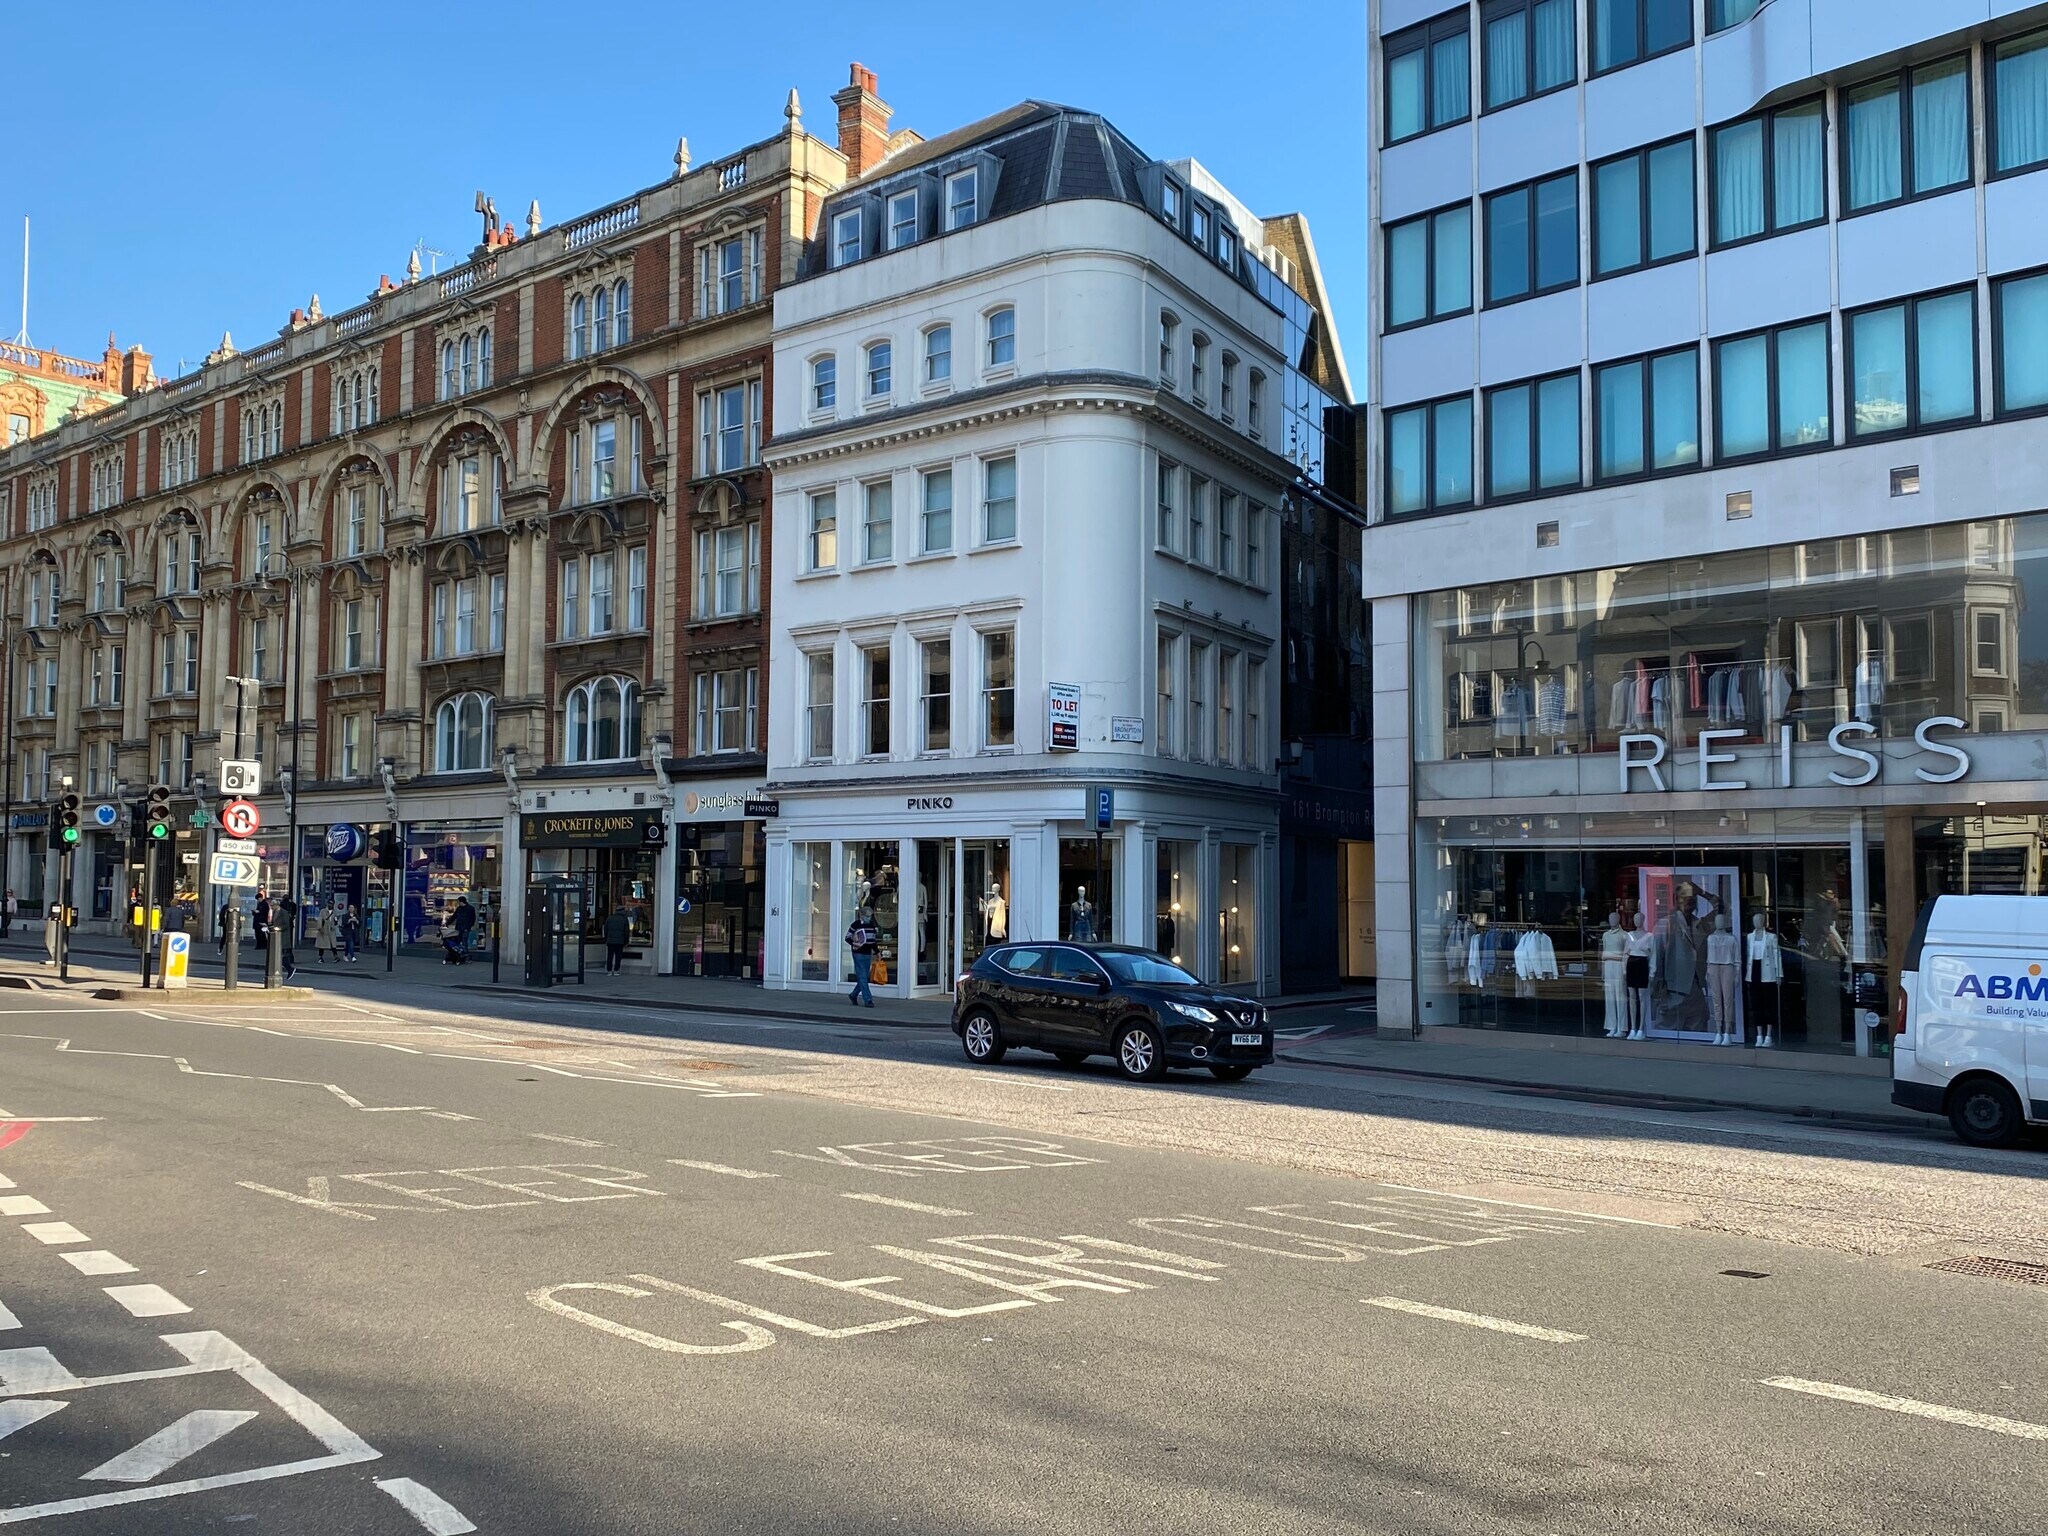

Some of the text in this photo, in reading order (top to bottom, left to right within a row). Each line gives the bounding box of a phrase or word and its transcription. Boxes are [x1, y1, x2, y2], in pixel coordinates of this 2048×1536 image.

[1052, 699, 1078, 712] TO LET
[1619, 716, 1973, 793] REISS
[701, 792, 744, 812] sunglass
[749, 804, 777, 812] PINKO
[908, 796, 953, 810] PINKO
[1100, 792, 1108, 812] P
[1293, 800, 1310, 818] 161
[1316, 802, 1360, 826] Brompton
[544, 816, 634, 834] CROCKETT & JONES
[222, 861, 235, 877] P
[1954, 974, 2048, 1002] ABM
[1986, 1005, 2048, 1018] Building Valu
[771, 1136, 1110, 1178] KEEP
[236, 1164, 668, 1222] KEEP
[1127, 1197, 1595, 1263] CLEAR
[525, 1234, 1227, 1355] CLEAR
